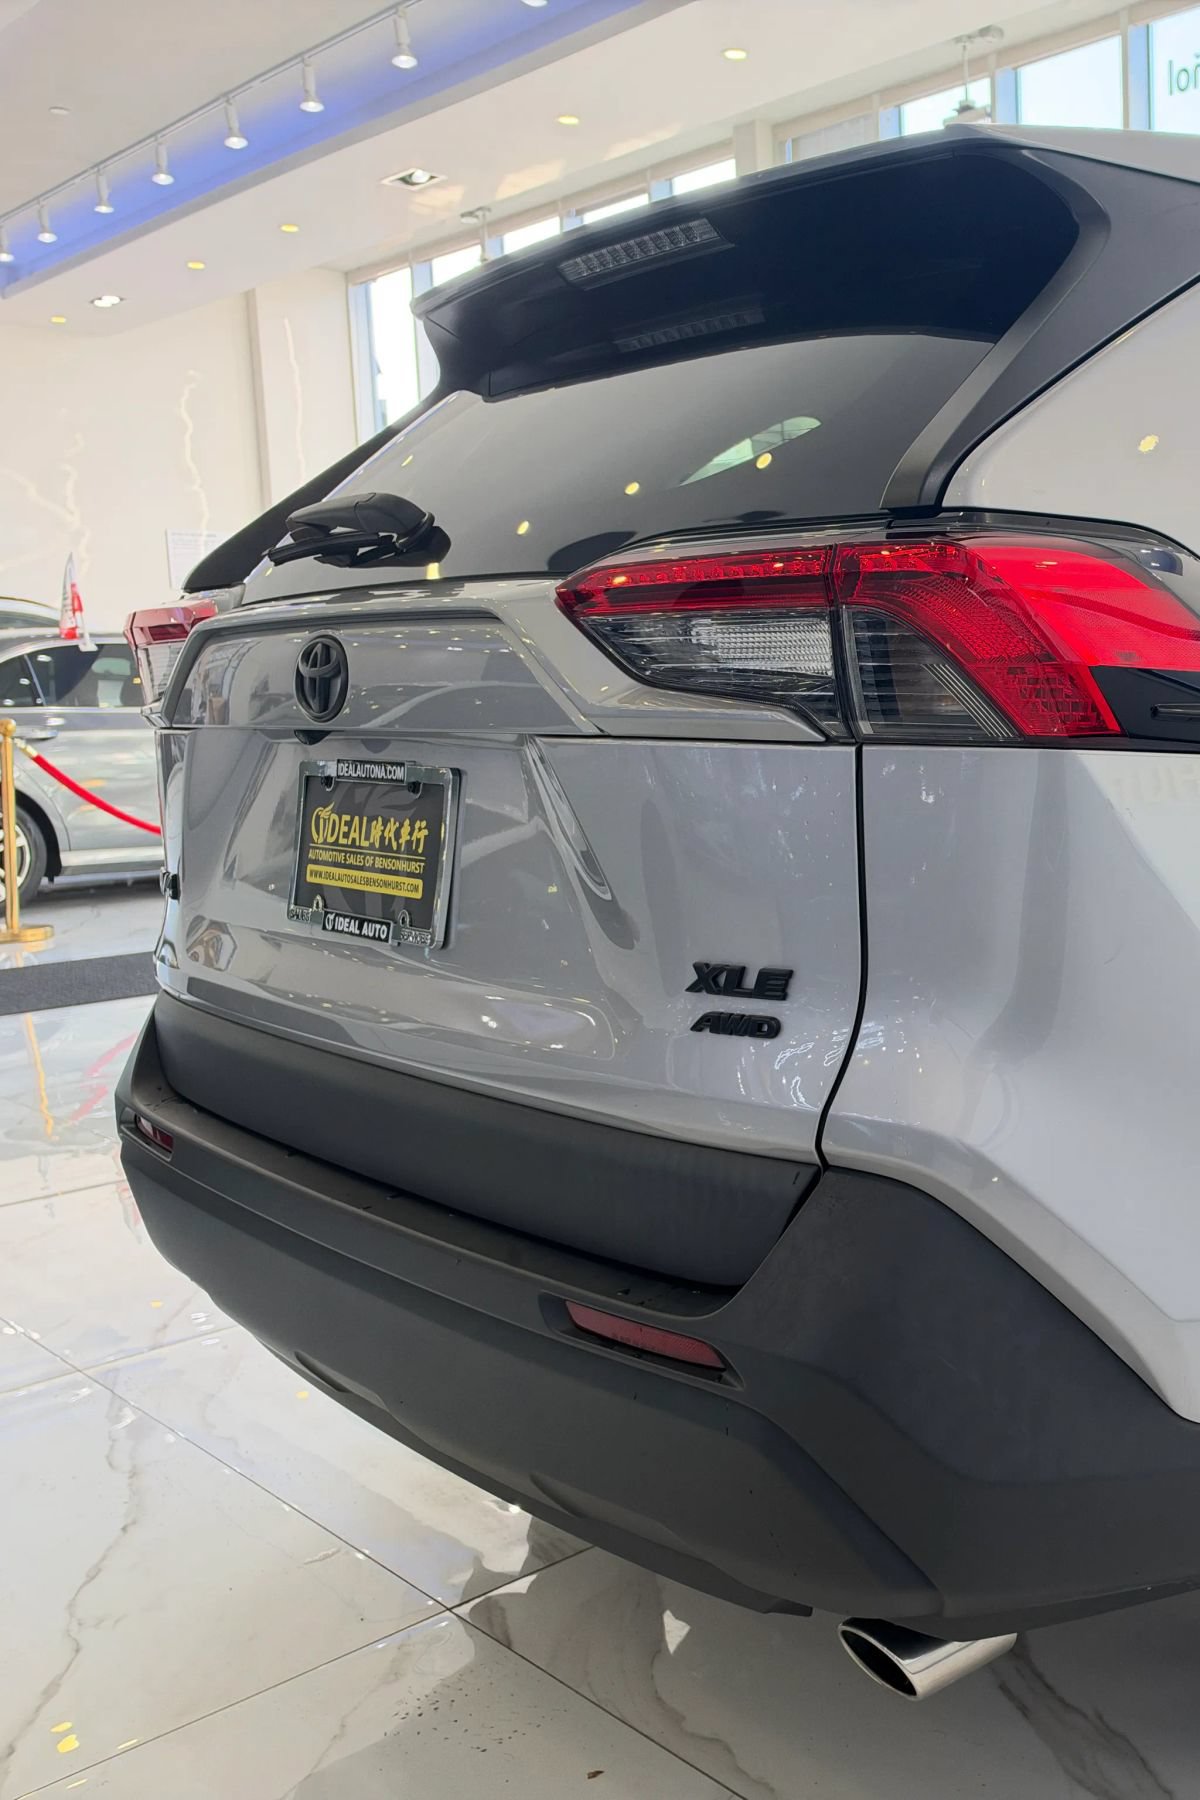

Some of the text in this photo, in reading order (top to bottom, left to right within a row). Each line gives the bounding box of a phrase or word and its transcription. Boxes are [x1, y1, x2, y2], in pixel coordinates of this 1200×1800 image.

[337, 762, 405, 781] IDEALAUTONA.COM
[308, 848, 425, 874] AUTOMOTIVE SALES OF BENSONHURST
[335, 916, 388, 940] IDEAL AUTO
[684, 961, 794, 1001] XLE
[690, 1010, 781, 1039] AWD
